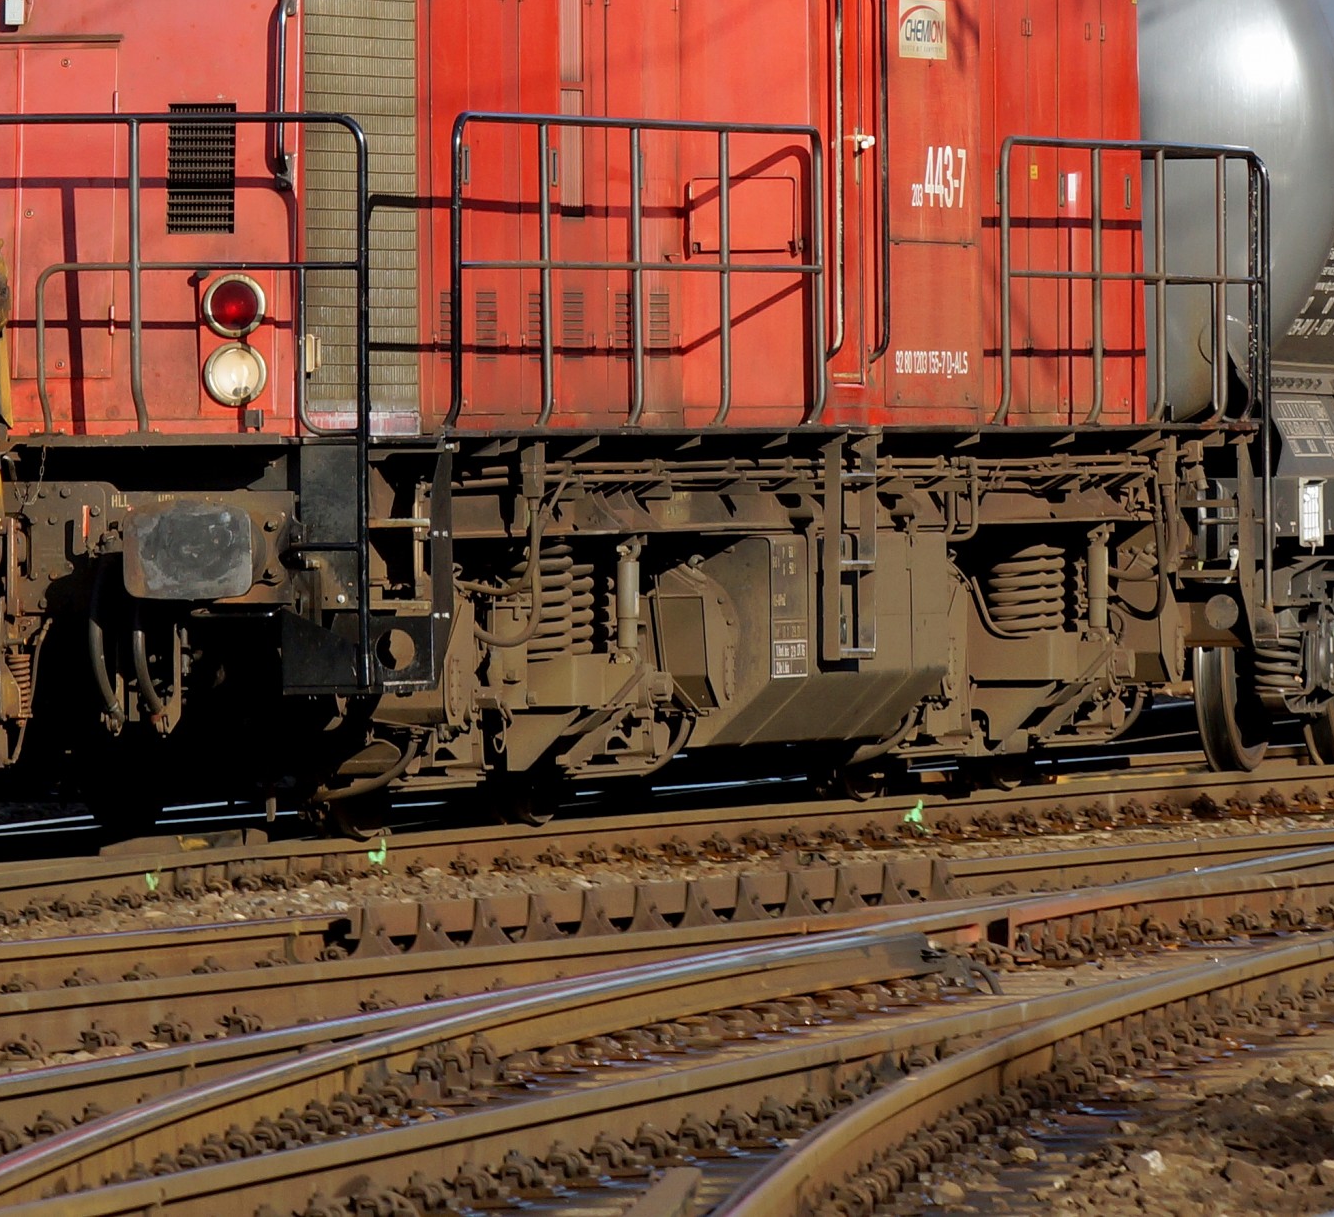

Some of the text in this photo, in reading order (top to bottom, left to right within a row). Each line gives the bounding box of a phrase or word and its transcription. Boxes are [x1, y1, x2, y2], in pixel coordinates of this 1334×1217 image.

[904, 19, 945, 43] CHEMION
[911, 145, 966, 208] 203 443-7
[895, 350, 904, 374] 92
[904, 350, 913, 374] 80
[913, 350, 927, 374] 1203
